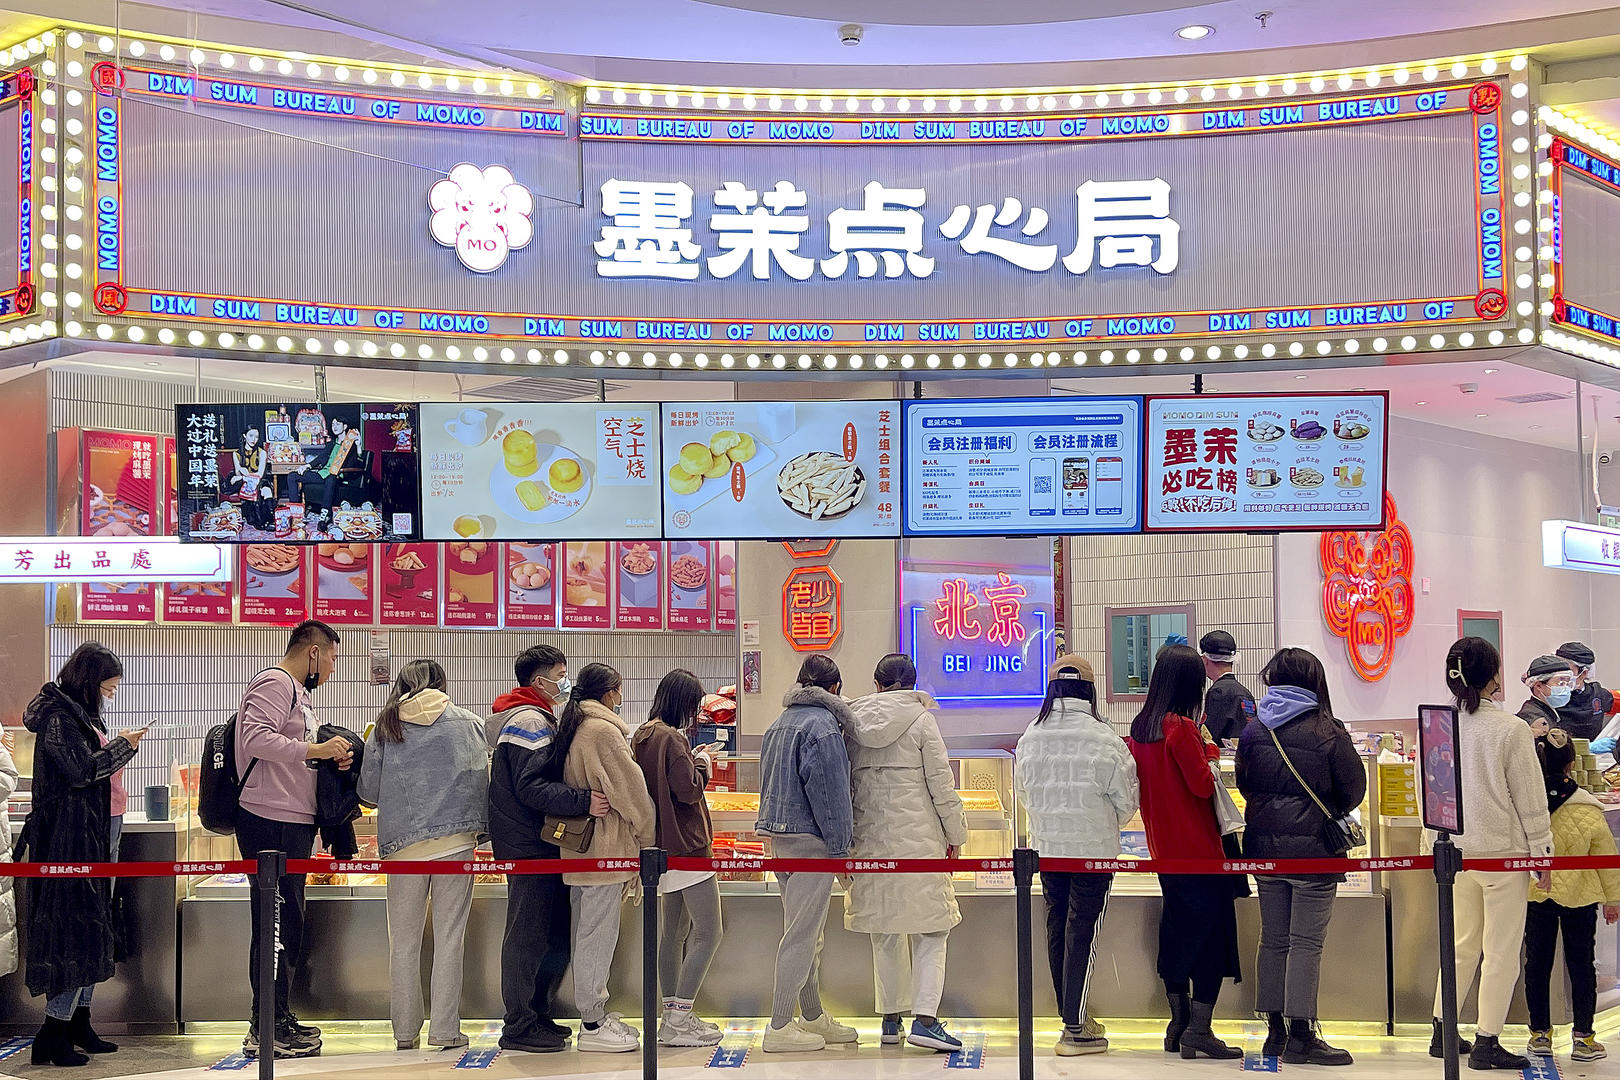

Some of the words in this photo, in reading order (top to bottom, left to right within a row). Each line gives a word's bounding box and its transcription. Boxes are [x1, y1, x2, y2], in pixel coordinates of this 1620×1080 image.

[148, 72, 194, 97] DIM
[210, 82, 258, 105] SUM
[273, 89, 356, 115] BUREAU
[370, 101, 402, 120] OF
[415, 104, 486, 127] MOMO
[520, 111, 563, 132] DIM
[580, 118, 623, 137] SUM
[636, 119, 713, 139] BUREAU
[727, 121, 756, 140] OF
[768, 121, 834, 140] MOMO
[860, 121, 900, 140] DIM
[912, 121, 957, 140] SUM
[969, 119, 1046, 139] BUREAU
[1058, 117, 1089, 137] OF
[1100, 115, 1170, 136] MOMO
[1202, 110, 1246, 130] DIM
[1259, 106, 1304, 126] SUM
[1317, 97, 1400, 122] BUREAU
[1415, 91, 1448, 112] OF
[97, 105, 118, 182] MOMO
[1568, 146, 1588, 171] DIM
[1590, 157, 1611, 181] SUM
[97, 196, 119, 272] MOMO
[468, 238, 497, 252] MO
[593, 177, 1181, 281] 墨茉点心局
[150, 294, 196, 317] DIM
[212, 299, 260, 321] SUM
[275, 303, 358, 327] BUREAU
[374, 311, 404, 329] OF
[420, 313, 489, 334] MOMO
[523, 317, 566, 337] DIM
[579, 319, 623, 339] SUM
[635, 320, 713, 341] BUREAU
[726, 323, 754, 341] OF
[768, 323, 834, 342] MOMO
[864, 323, 904, 342] DIM
[918, 323, 960, 341] SUM
[973, 321, 1050, 340] BUREAU
[1064, 319, 1094, 338] OF
[1107, 316, 1176, 337] MOMO
[1208, 313, 1252, 332] DIM
[1265, 309, 1312, 329] SUM
[1325, 303, 1408, 326] BUREAU
[1423, 301, 1455, 320] OF
[1569, 306, 1590, 328] DIM
[1592, 313, 1613, 335] SUM
[87, 436, 132, 450] MOMO
[186, 412, 204, 488] 大过中国年
[202, 412, 218, 488] 送礼送墨茉
[603, 416, 624, 459] 空气
[625, 416, 646, 480] 芝士烧
[878, 410, 891, 493] 芝士组合套餐
[928, 436, 1012, 451] 会员注册福利
[1033, 433, 1118, 450] 会员注册流程
[1162, 427, 1238, 468] 墨茉
[1162, 466, 1238, 496] 必吃榜
[877, 502, 892, 513] 48
[14, 548, 152, 571] 芳出品處
[137, 604, 145, 612] 19
[790, 580, 832, 609] 老少
[934, 572, 1028, 647] 北京
[791, 612, 833, 640] 皆宜
[1357, 621, 1385, 646] MO
[944, 654, 971, 673] BEI
[984, 654, 1023, 673] JING
